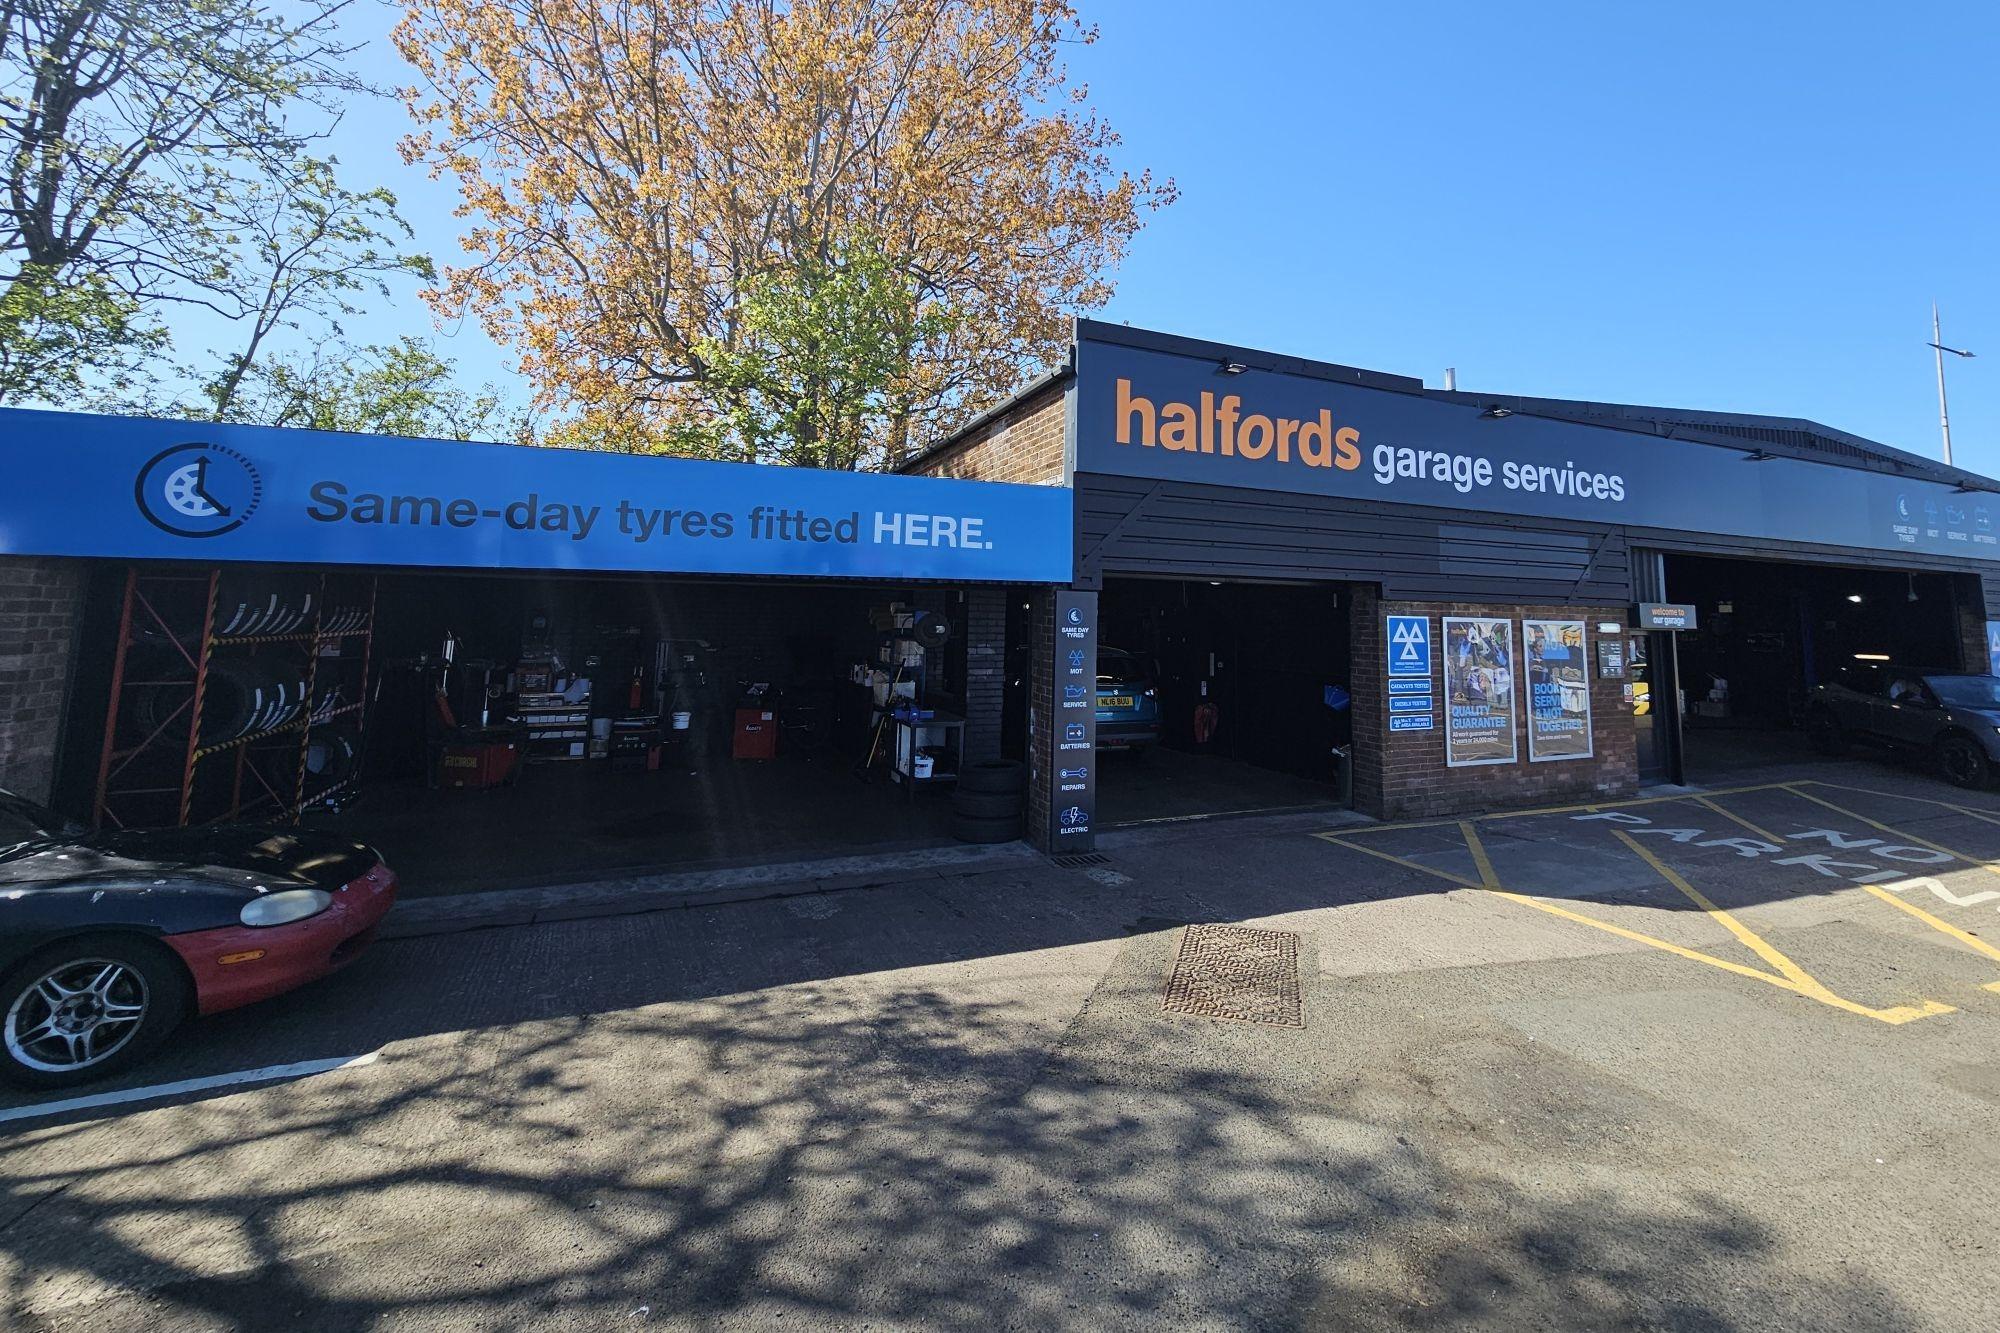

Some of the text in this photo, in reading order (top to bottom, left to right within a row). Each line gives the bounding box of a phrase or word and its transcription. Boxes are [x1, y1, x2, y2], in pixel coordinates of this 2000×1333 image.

[1116, 378, 1625, 501] halfords garage services
[306, 480, 993, 550] Same-day tyres fitted HERE.
[1652, 608, 1677, 616] welcome
[1664, 617, 1685, 626] garage
[1452, 704, 1490, 717] QUALITY
[1543, 707, 1563, 719] MOT
[1452, 717, 1506, 729] GUARANTEE
[1536, 719, 1582, 732] TOGETHER
[1470, 730, 1492, 738] guaranteed
[1785, 824, 1958, 863] NO
[1569, 811, 2000, 913] PARKIN
